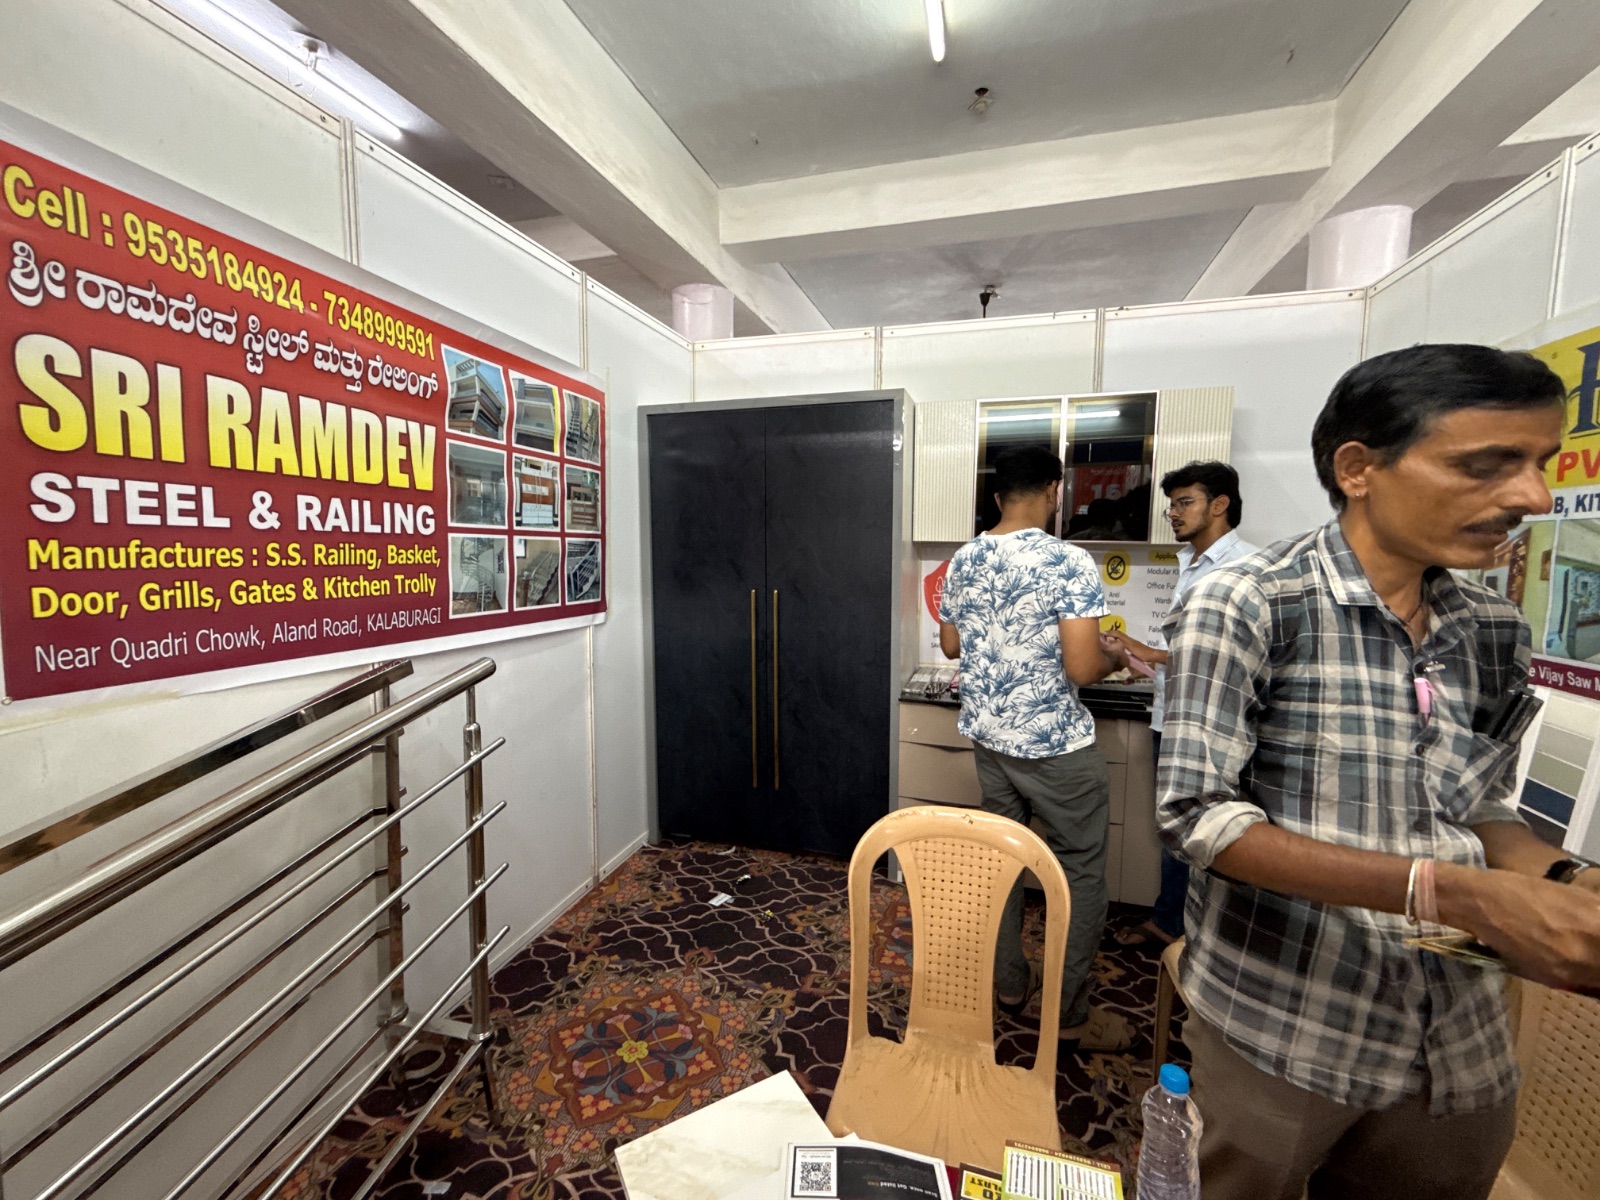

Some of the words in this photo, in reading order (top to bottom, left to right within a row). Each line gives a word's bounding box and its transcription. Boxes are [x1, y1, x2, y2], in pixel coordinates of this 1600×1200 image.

[3, 165, 89, 238] Cell
[102, 213, 114, 247] :
[123, 212, 304, 313] 9535184924
[323, 290, 435, 361] 7348999591
[8, 241, 67, 307] ಶ್ರೀ
[75, 268, 238, 345] ರಾಮದೇವ
[243, 315, 309, 375] ಸ್ಟೀಲ್
[313, 339, 364, 393] ಮತ್ತು
[367, 354, 439, 399] ರೇಲಿಂಗ್
[14, 333, 186, 463] SRI
[206, 374, 437, 491] RAMDEV
[30, 472, 231, 528] STEEL
[248, 490, 281, 530] &
[296, 494, 435, 535] RAILING
[27, 539, 244, 570] Manufactures
[252, 548, 258, 567] :
[266, 543, 307, 567] S.S.
[314, 543, 382, 569] Railing,
[387, 544, 441, 568] Basket,
[1147, 581, 1165, 590] Office
[31, 586, 129, 619] Door,
[139, 580, 222, 612] Grills,
[229, 579, 296, 606] Gates
[302, 577, 319, 600] &
[324, 574, 390, 599] Kitchen
[394, 572, 436, 597] Trolly
[35, 645, 101, 672] Near
[110, 631, 188, 668] Quadri
[195, 625, 265, 653] Chowk,
[272, 619, 317, 643] Aland
[323, 615, 362, 637] Road,
[367, 607, 442, 632] KALABURAGI
[1538, 665, 1564, 686] Vijay
[1567, 671, 1592, 689] Saw
